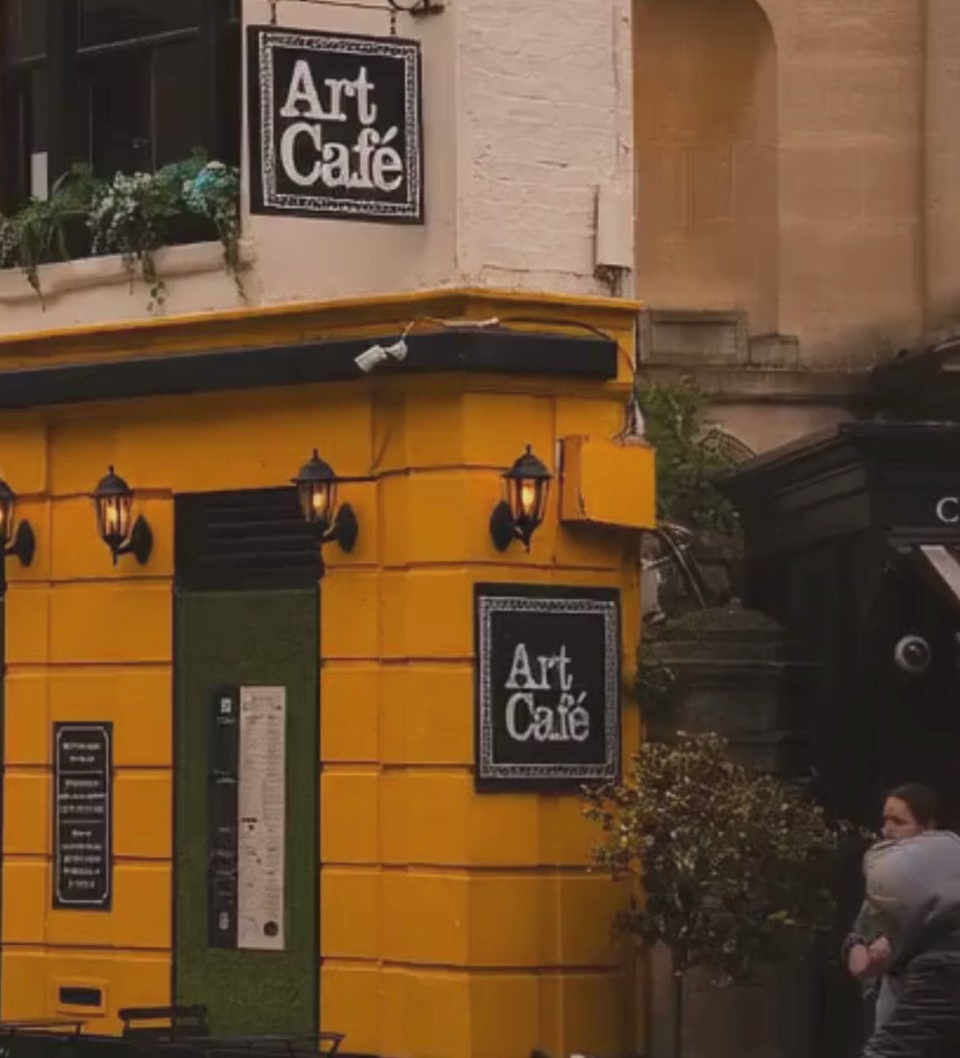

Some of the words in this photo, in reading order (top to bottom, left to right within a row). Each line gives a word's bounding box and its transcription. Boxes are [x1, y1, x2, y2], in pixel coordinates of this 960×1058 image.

[280, 59, 378, 125] Art
[280, 122, 403, 192] Café
[504, 643, 574, 691] Art
[505, 690, 590, 742] Café
